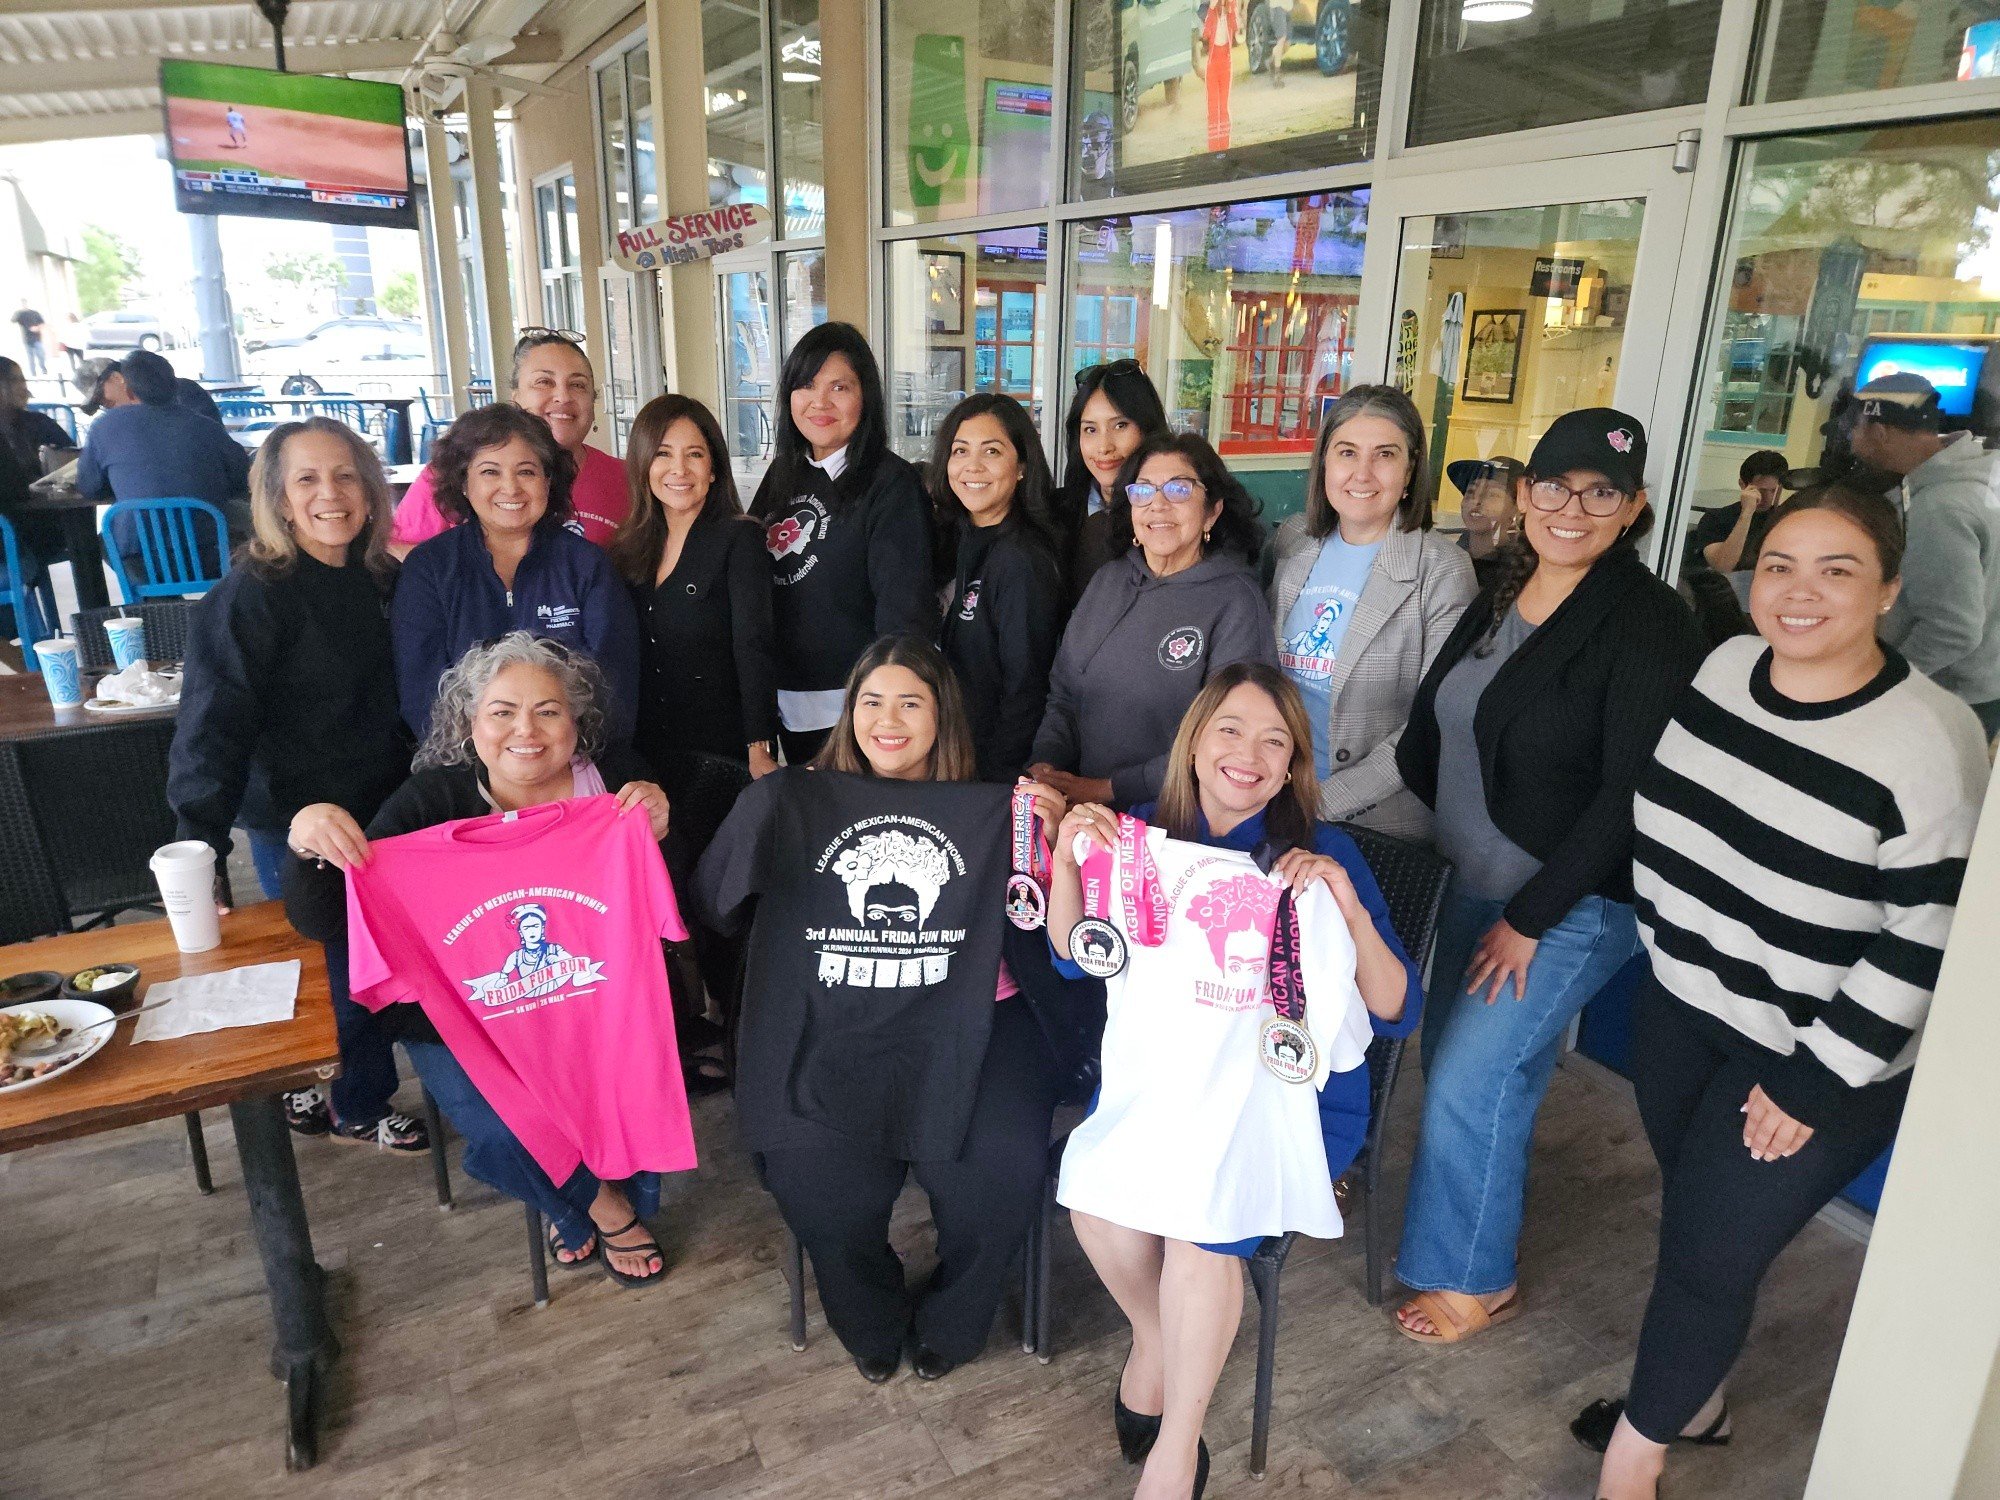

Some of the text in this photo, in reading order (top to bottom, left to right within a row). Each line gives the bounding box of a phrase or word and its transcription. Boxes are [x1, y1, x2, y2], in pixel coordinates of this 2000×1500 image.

[616, 203, 758, 258] FULL SERVICE
[636, 251, 657, 268] @
[660, 243, 699, 264] High
[1535, 260, 1582, 276] Restrooms
[1863, 400, 1882, 416] CA
[787, 554, 819, 585] Leadership
[1280, 653, 1334, 673] IDA FUN RU
[815, 814, 967, 876] LEAGUE OF MEXICAN-AMERICAN WOMEN
[1014, 795, 1025, 872] AMERICA
[1121, 816, 1136, 864] MEXIC
[1121, 868, 1134, 892] OF
[1168, 864, 1197, 915] LEAGUE OF
[442, 886, 608, 946] LEAGUE OF MEXICAN-AMERICAN WOMEN
[1085, 878, 1100, 919] OMEN
[1150, 883, 1167, 942] COUNTY
[805, 928, 967, 944] 3rd ANNUAL FRIDA FUN RUN
[897, 947, 912, 955] 2024
[1070, 934, 1078, 956] LEAGUE
[1078, 921, 1099, 931] MEXICAN
[1098, 923, 1121, 947] AMERICAN
[486, 958, 587, 1005] FRIDA FUN RUN
[1272, 961, 1290, 1017] XICAN
[516, 993, 566, 1014] 5K RUN 2K WALK
[1269, 1022, 1291, 1031] MEXICAN
[1290, 1026, 1312, 1050] AMERICAN
